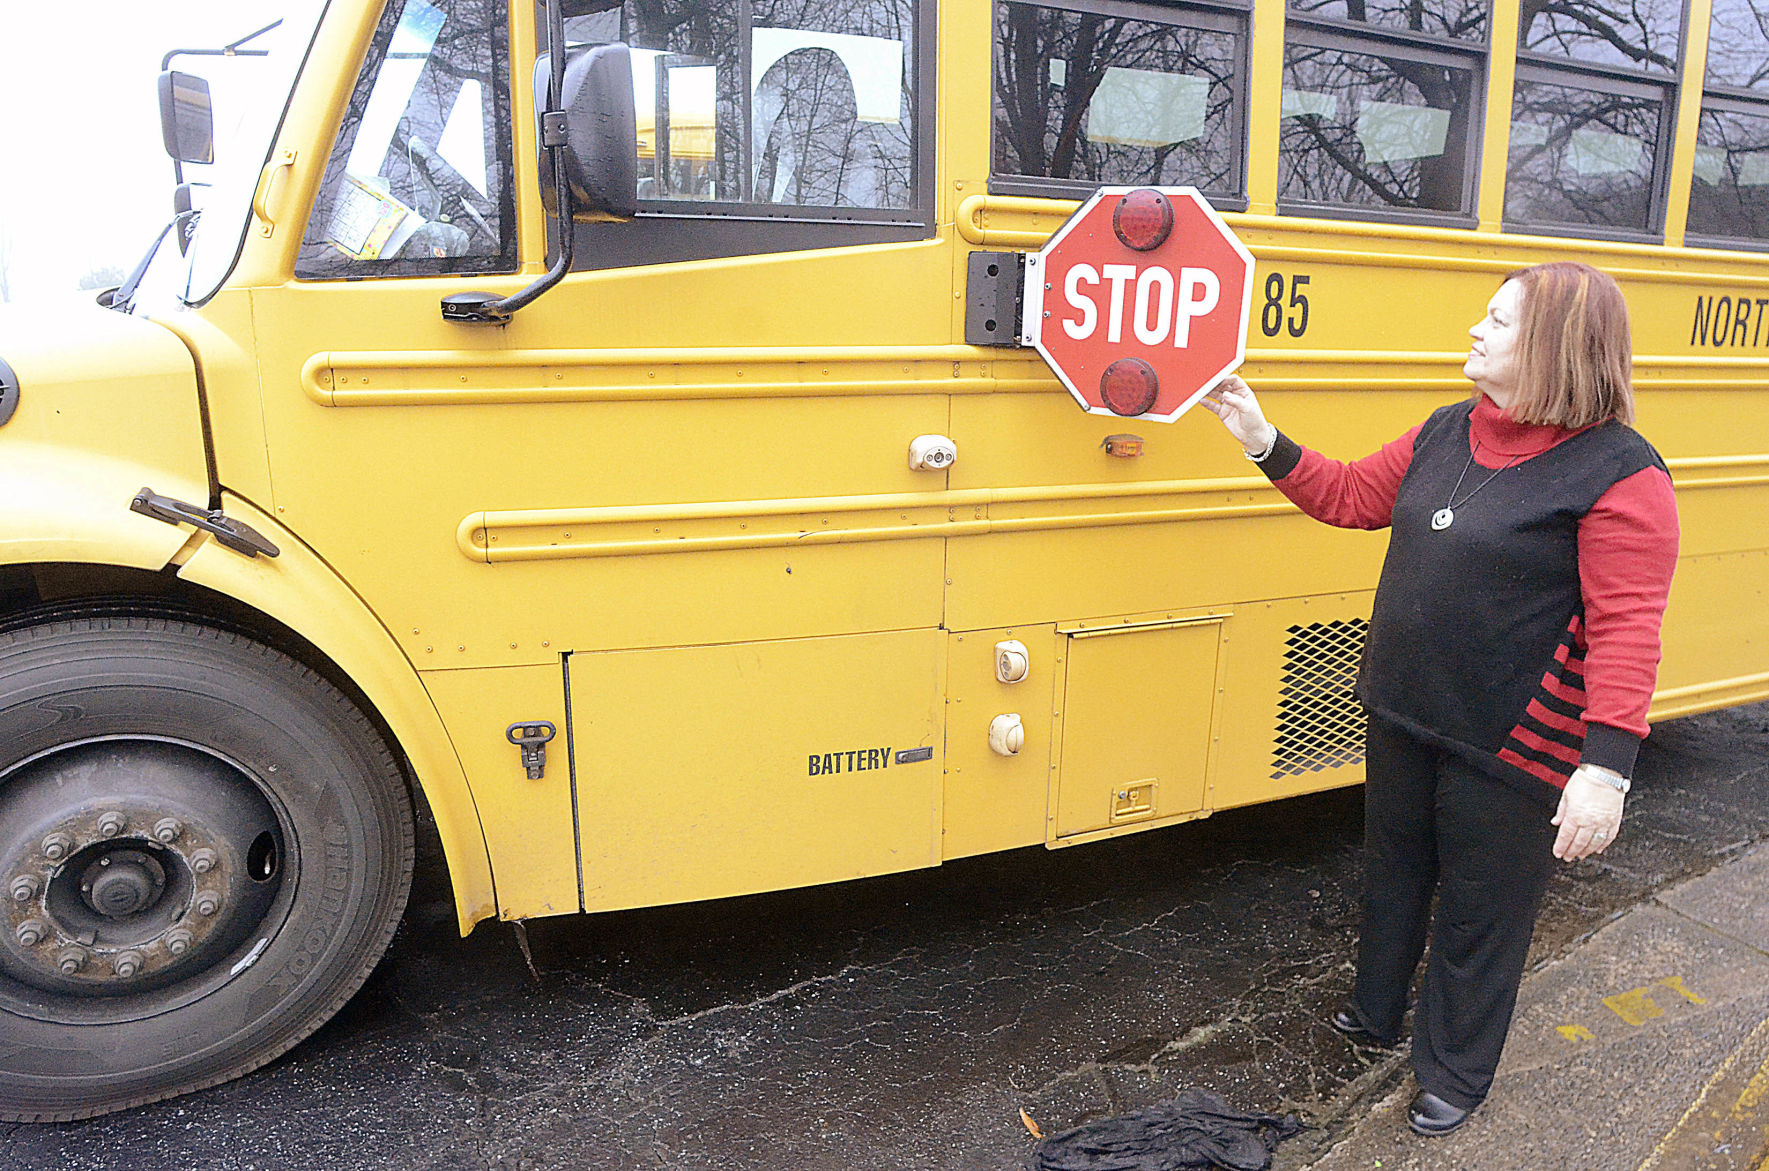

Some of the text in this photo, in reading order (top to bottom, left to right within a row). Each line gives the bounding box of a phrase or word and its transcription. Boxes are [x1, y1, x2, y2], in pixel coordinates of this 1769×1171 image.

[1062, 263, 1221, 348] STOP
[1261, 272, 1311, 338] 85
[1690, 295, 1769, 347] NORT
[808, 747, 891, 776] BATTERY
